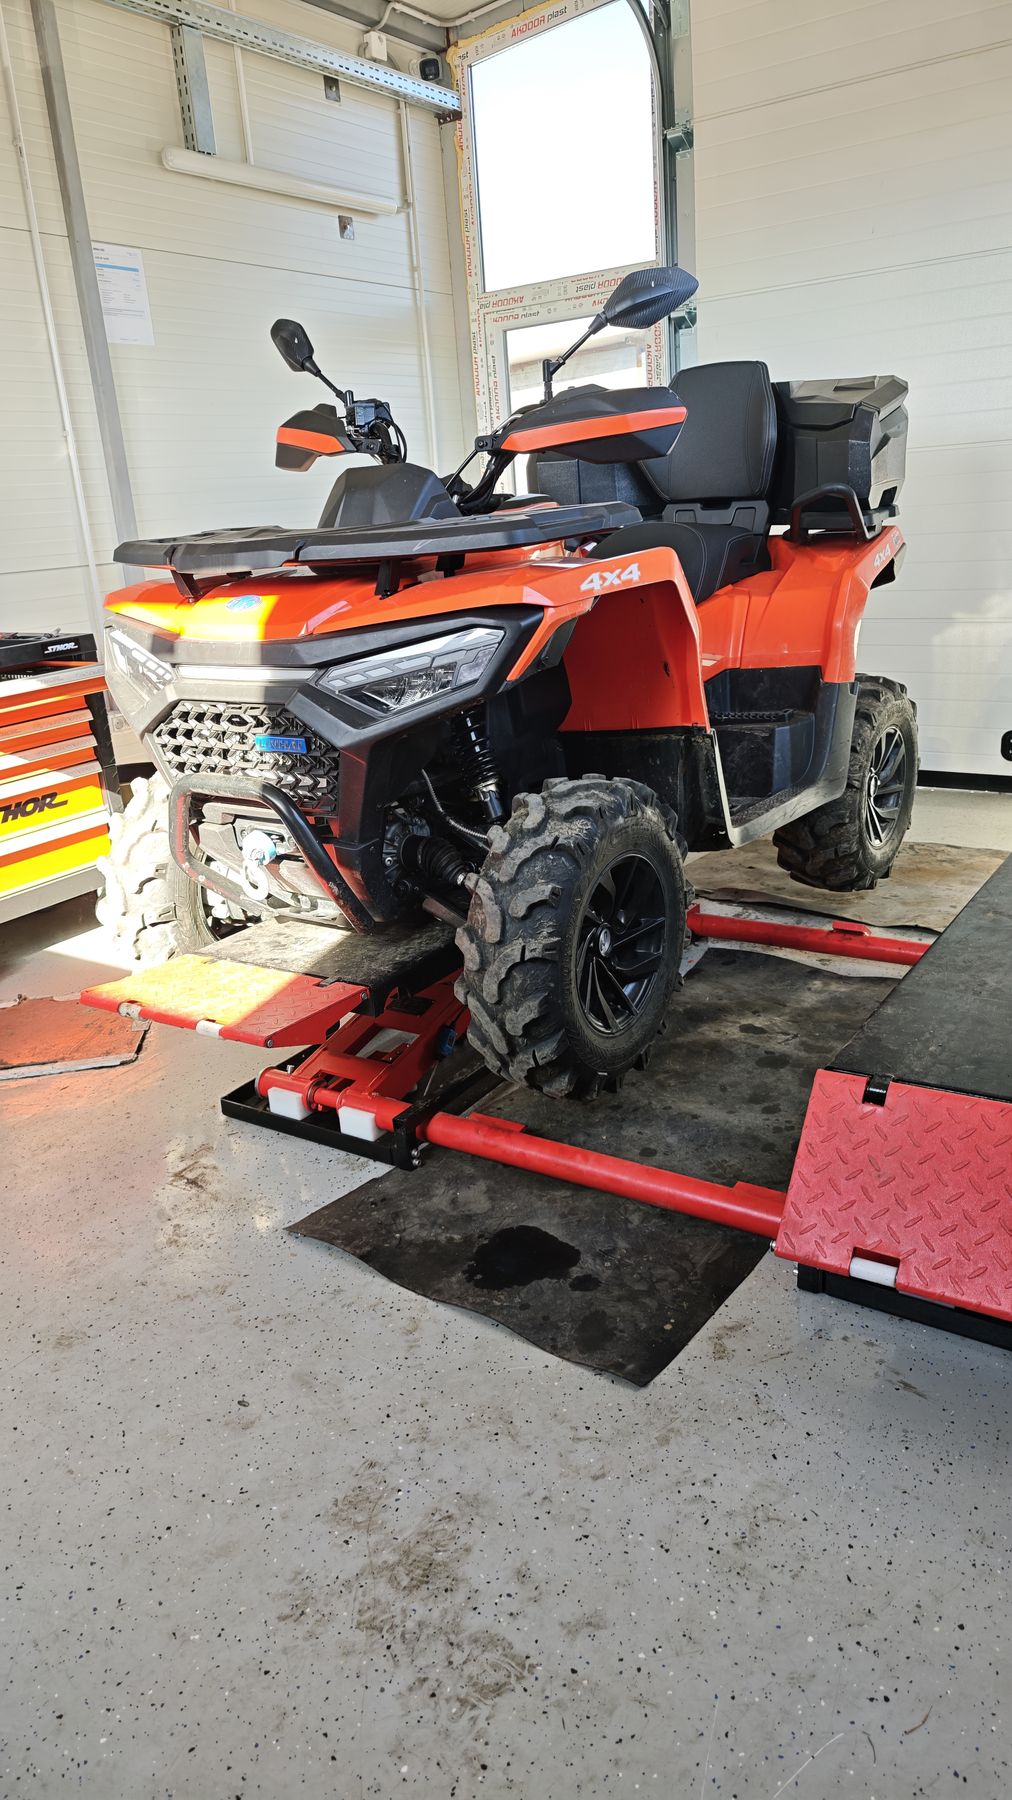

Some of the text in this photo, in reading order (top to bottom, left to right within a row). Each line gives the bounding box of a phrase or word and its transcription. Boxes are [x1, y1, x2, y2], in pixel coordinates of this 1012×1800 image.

[547, 6, 567, 22] plast
[576, 281, 596, 293] plast
[44, 642, 78, 653] STHOR
